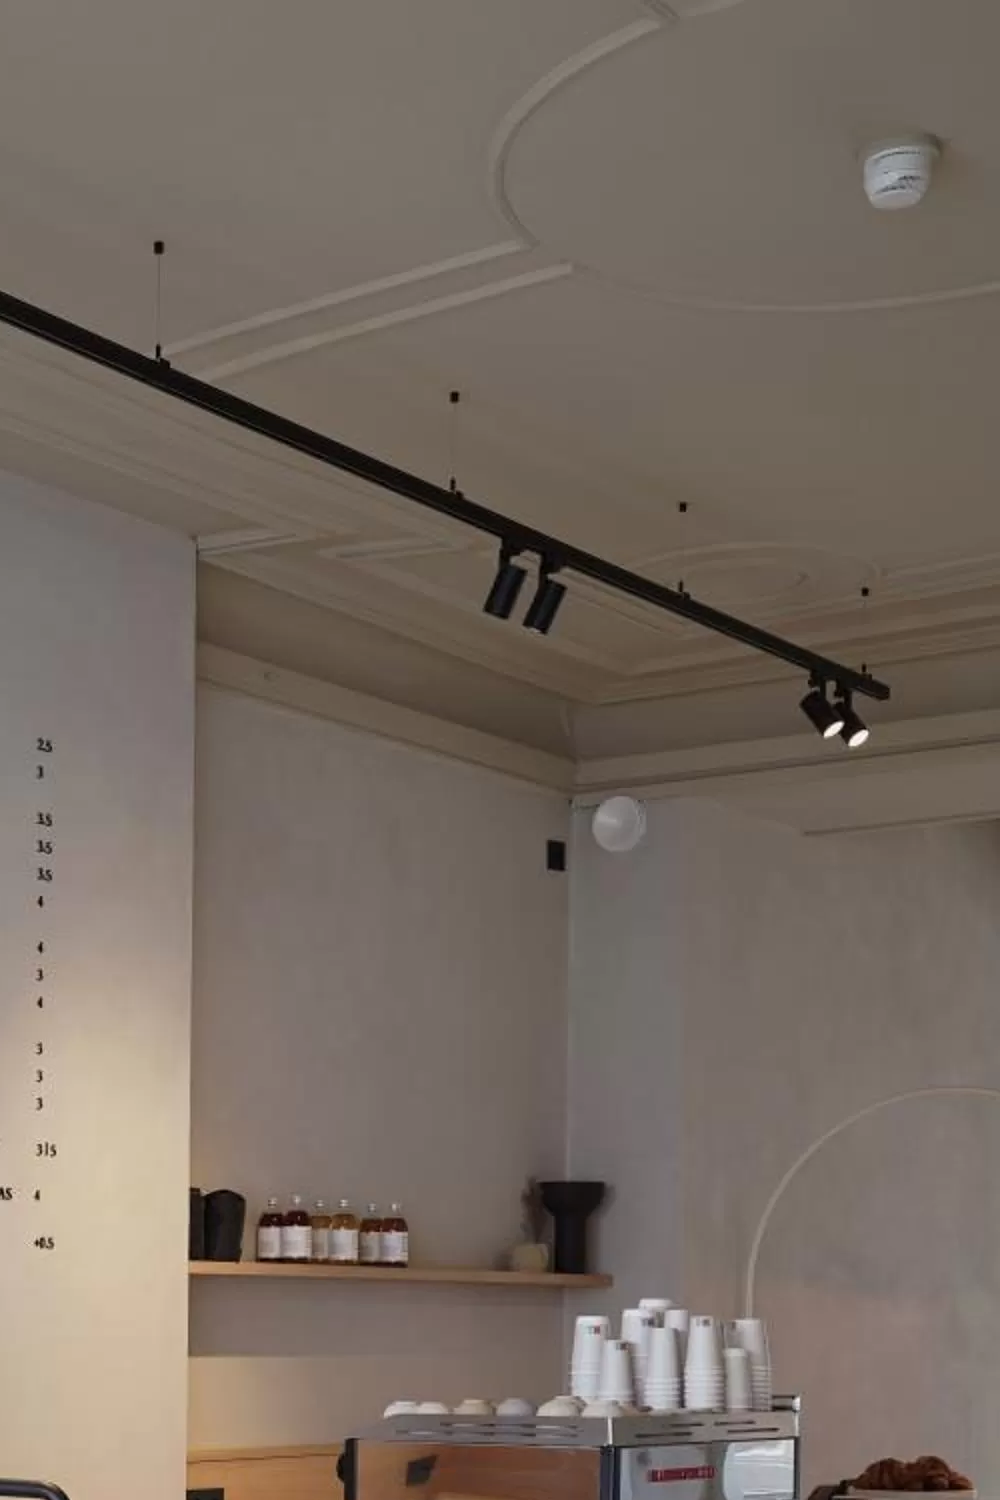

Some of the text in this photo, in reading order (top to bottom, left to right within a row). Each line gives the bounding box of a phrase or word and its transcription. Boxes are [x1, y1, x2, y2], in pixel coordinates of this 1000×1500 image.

[36, 1042, 43, 1055] 3
[36, 1070, 43, 1083] 3
[36, 1097, 43, 1111] 3
